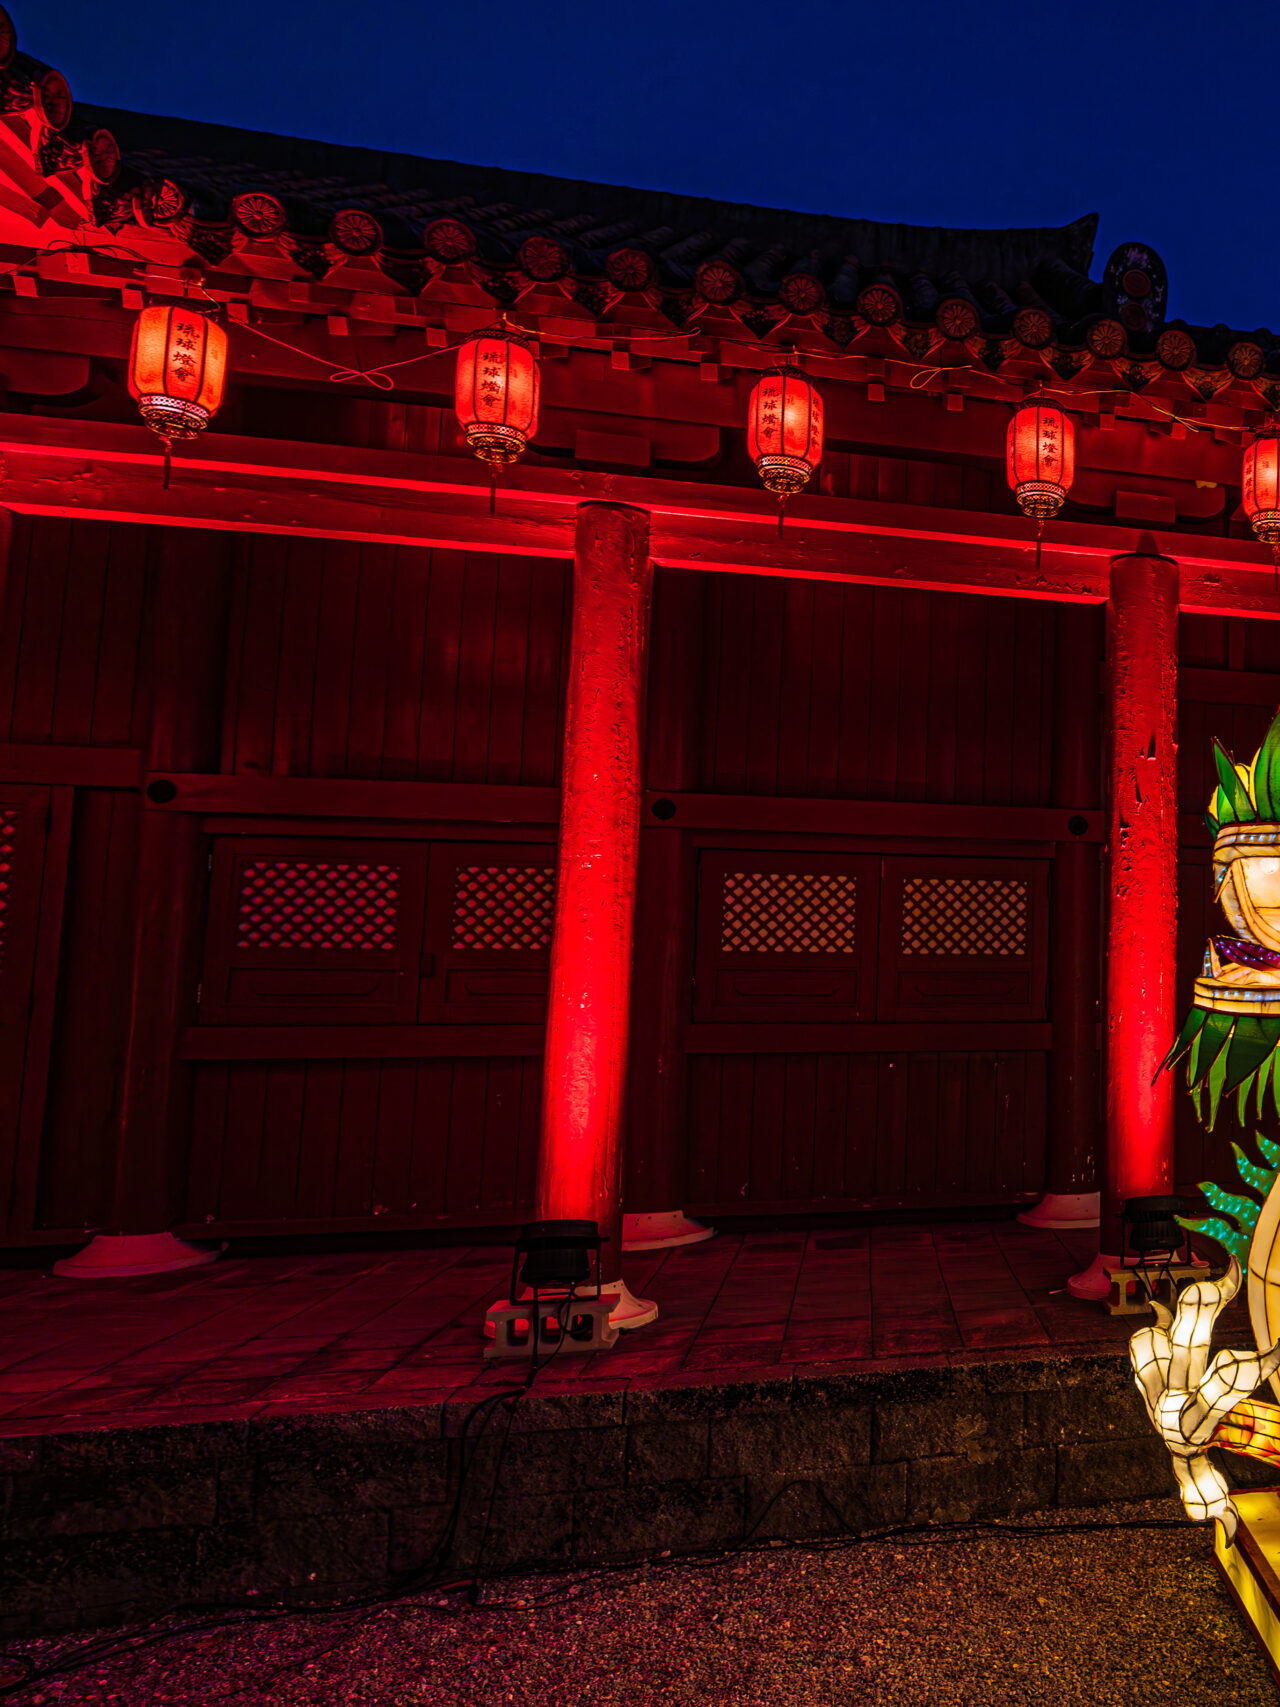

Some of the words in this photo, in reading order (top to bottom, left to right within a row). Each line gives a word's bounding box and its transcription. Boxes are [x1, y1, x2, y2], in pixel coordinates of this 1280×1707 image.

[172, 322, 200, 382] 琉球燈會
[479, 351, 503, 408] 琉球燈會
[761, 385, 779, 439] 琉球燈會
[1042, 416, 1058, 468] 琉球燈會
